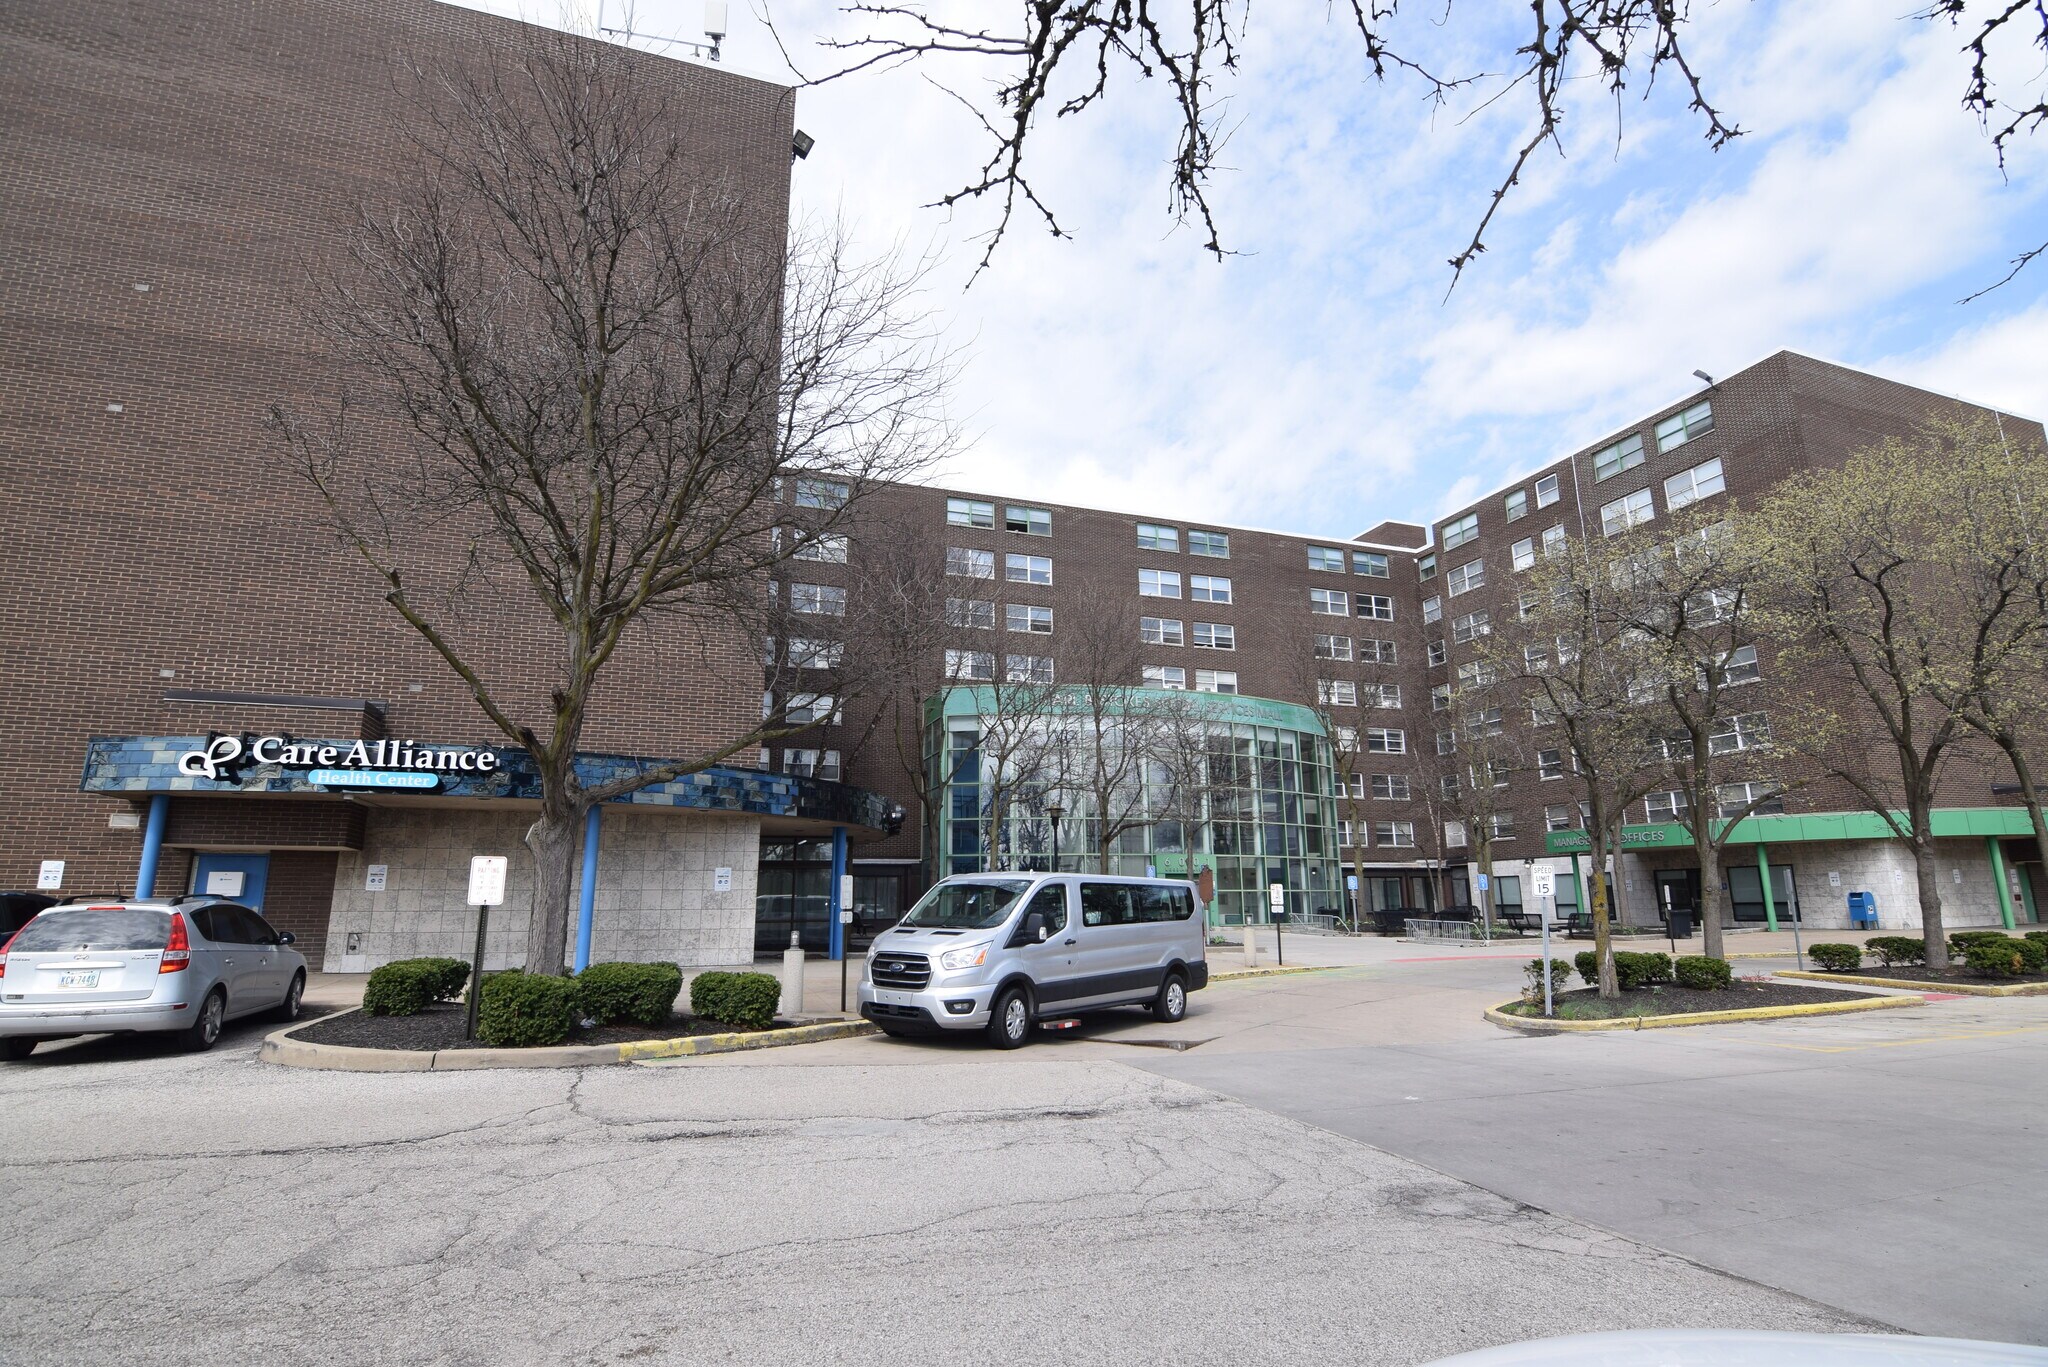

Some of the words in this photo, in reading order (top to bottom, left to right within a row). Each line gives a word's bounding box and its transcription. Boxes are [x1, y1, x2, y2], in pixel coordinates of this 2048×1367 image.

[1100, 695, 1150, 708] SOKES
[1257, 704, 1283, 722] MALL
[252, 737, 338, 766] Care
[341, 738, 495, 771] Alliance
[317, 770, 371, 785] Health
[374, 772, 430, 787] Center
[1620, 830, 1665, 843] OFFICES
[1533, 866, 1552, 874] SPEED
[1535, 874, 1550, 882] LIMIT
[1537, 883, 1550, 894] 15
